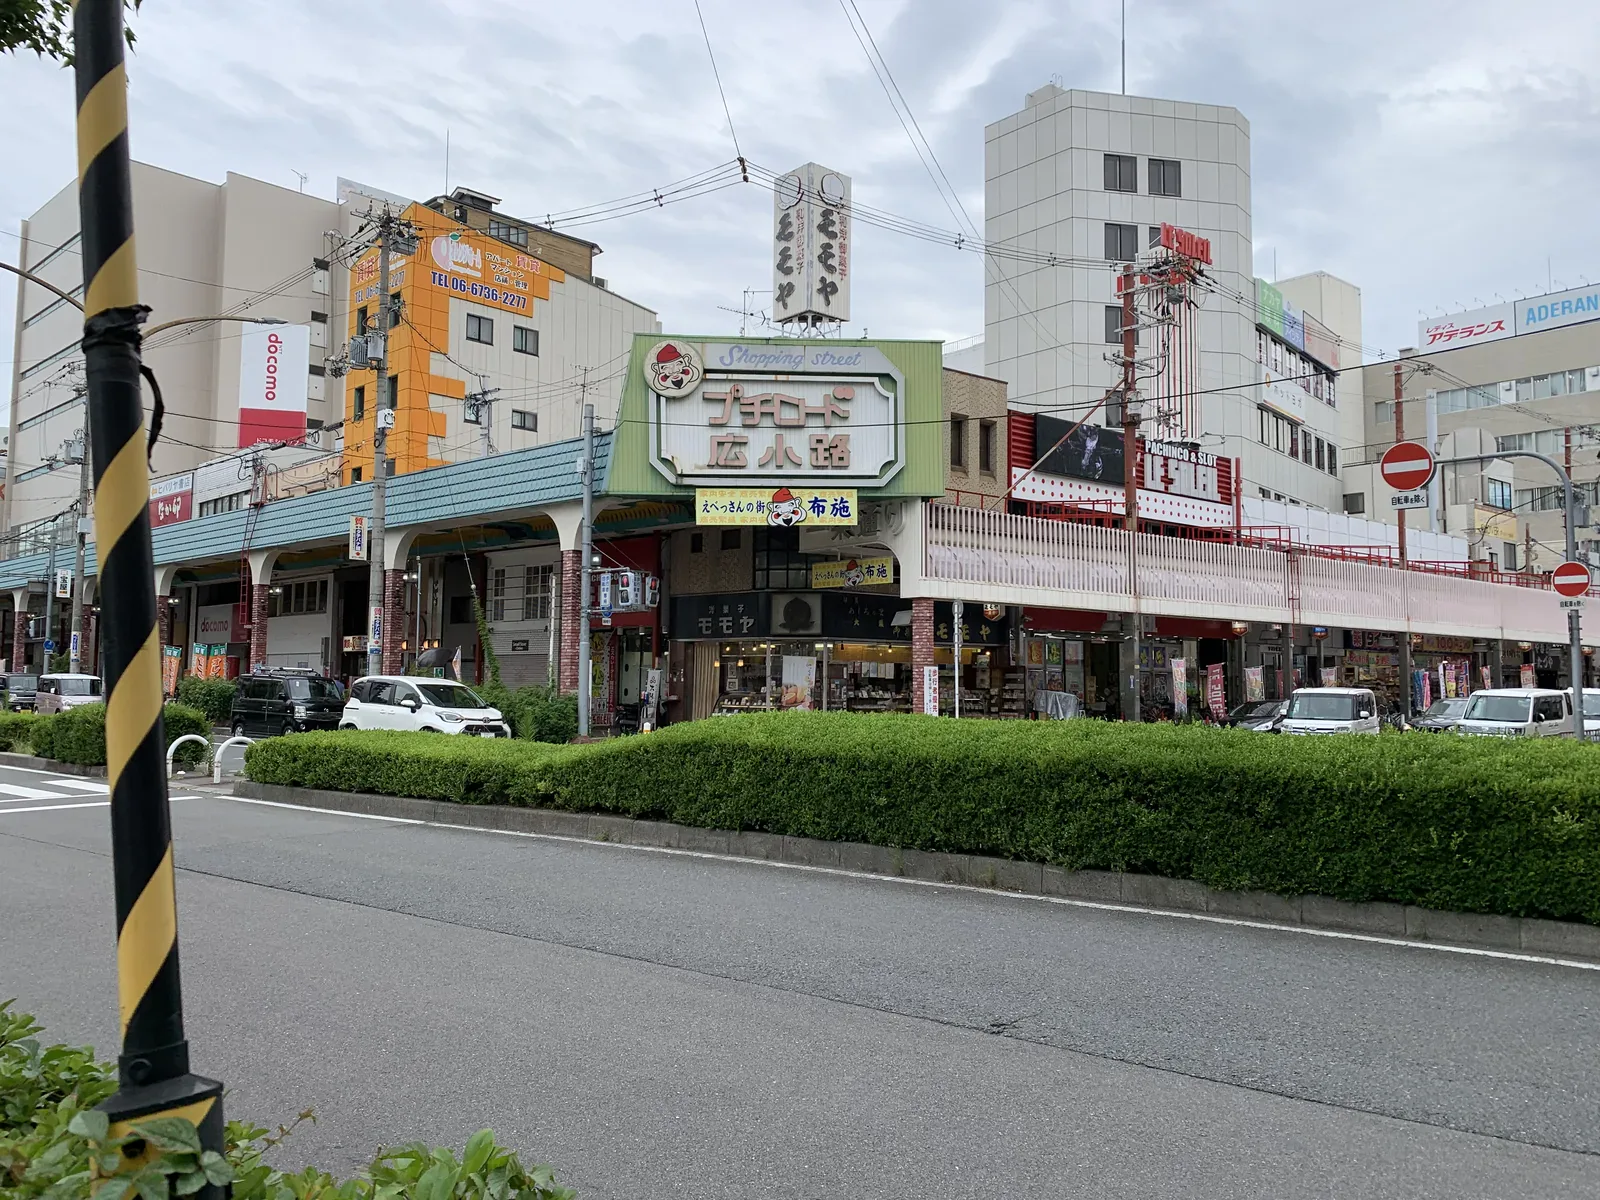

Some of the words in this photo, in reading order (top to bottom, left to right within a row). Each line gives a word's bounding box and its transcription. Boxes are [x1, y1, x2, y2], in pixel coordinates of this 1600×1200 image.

[485, 252, 512, 266] アパート
[516, 256, 541, 273] 賃貸
[490, 263, 524, 279] マンション
[431, 271, 449, 288] TEL
[451, 277, 527, 309] 06-6736-2277
[1426, 322, 1455, 334] レディス
[1426, 319, 1506, 346] アデランス
[265, 333, 283, 401] docomo
[719, 345, 805, 370] Shopping
[811, 352, 862, 366] street
[702, 383, 856, 427] プチロード
[707, 433, 851, 467] 広小路
[1145, 440, 1189, 461] PACHINCO
[1190, 452, 1197, 463] &
[1198, 452, 1218, 467] SLOT
[702, 500, 765, 515] えべっさんの街
[807, 496, 851, 518] 布施
[1391, 494, 1425, 506] 自転車を除く
[865, 563, 888, 579] 布施
[201, 617, 229, 633] docomo
[699, 615, 755, 635] モモヤ
